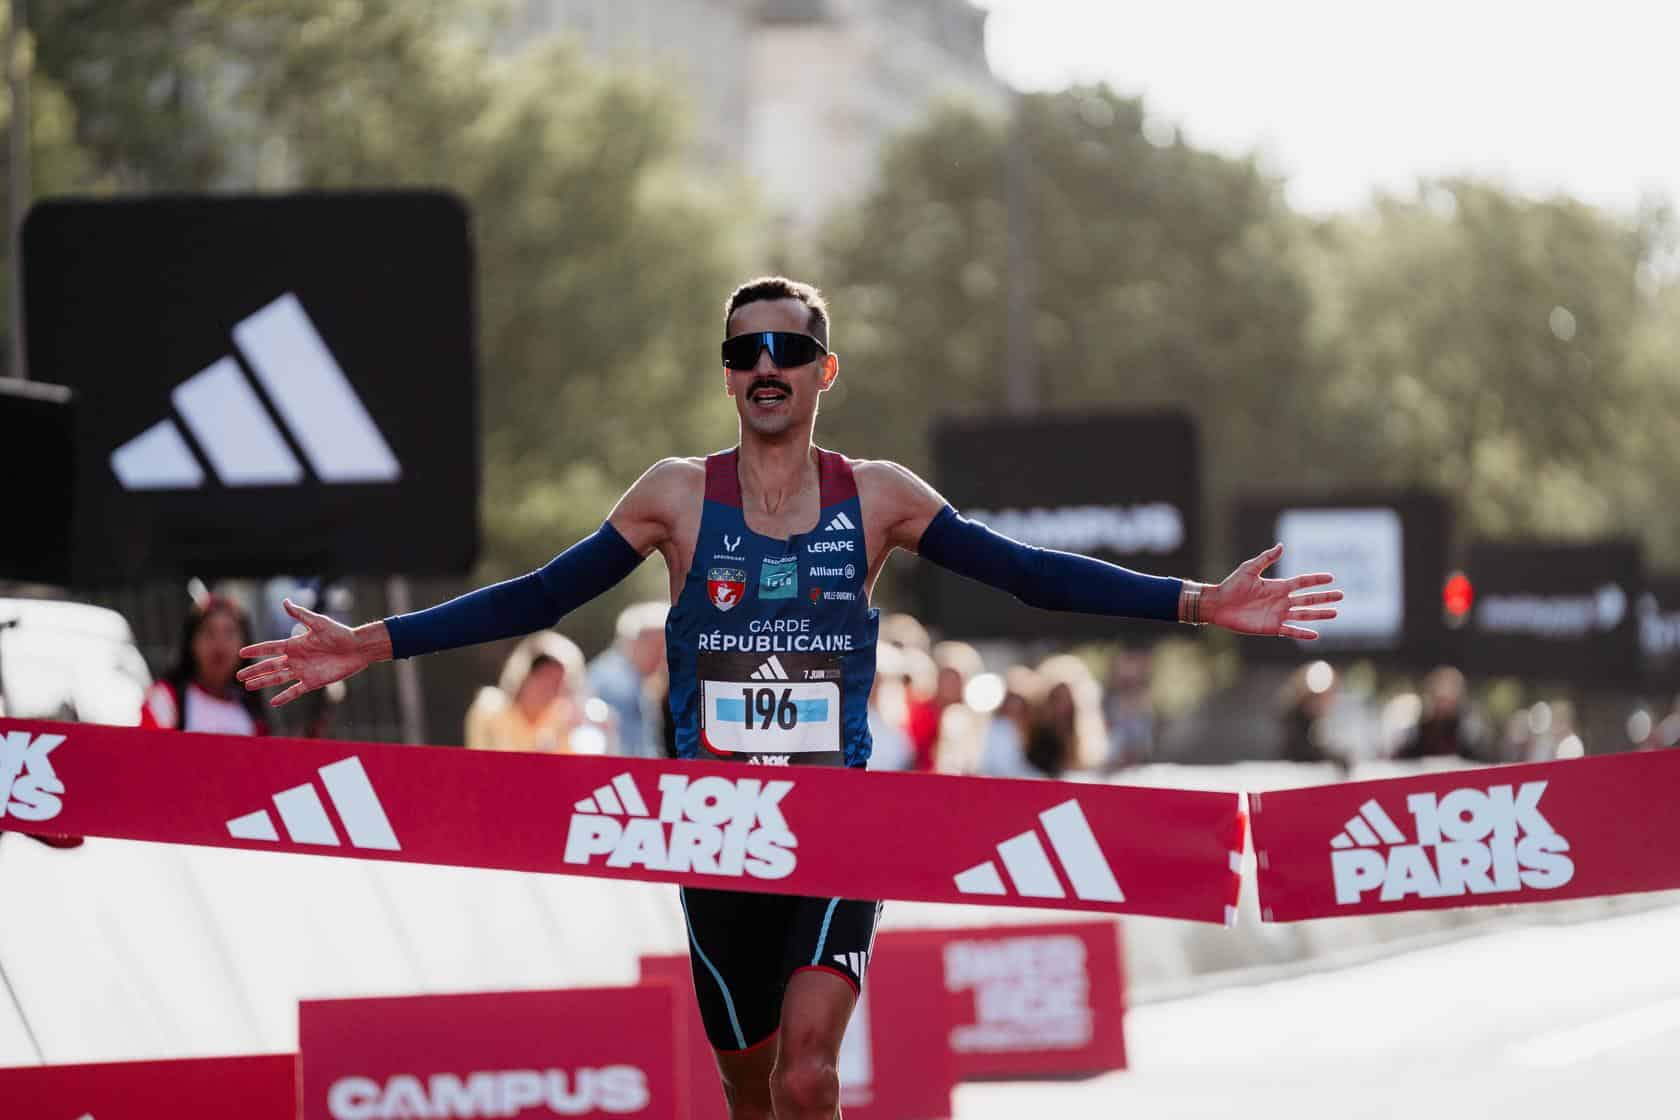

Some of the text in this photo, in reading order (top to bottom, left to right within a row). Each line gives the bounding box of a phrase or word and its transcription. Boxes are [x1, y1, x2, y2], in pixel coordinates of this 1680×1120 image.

[808, 541, 854, 553] LEPAPE
[809, 566, 844, 577] Allianz
[699, 631, 854, 652] RÉPUBLICAINE
[750, 619, 811, 633] GARDE
[803, 670, 809, 680] 7
[742, 687, 798, 730] 196
[762, 755, 791, 767] 10K
[658, 774, 796, 831] 10K
[1407, 780, 1549, 844] 10K
[563, 813, 799, 880] PARIS
[1330, 834, 1575, 905] PARIS
[327, 1064, 651, 1120] CAMPUS
